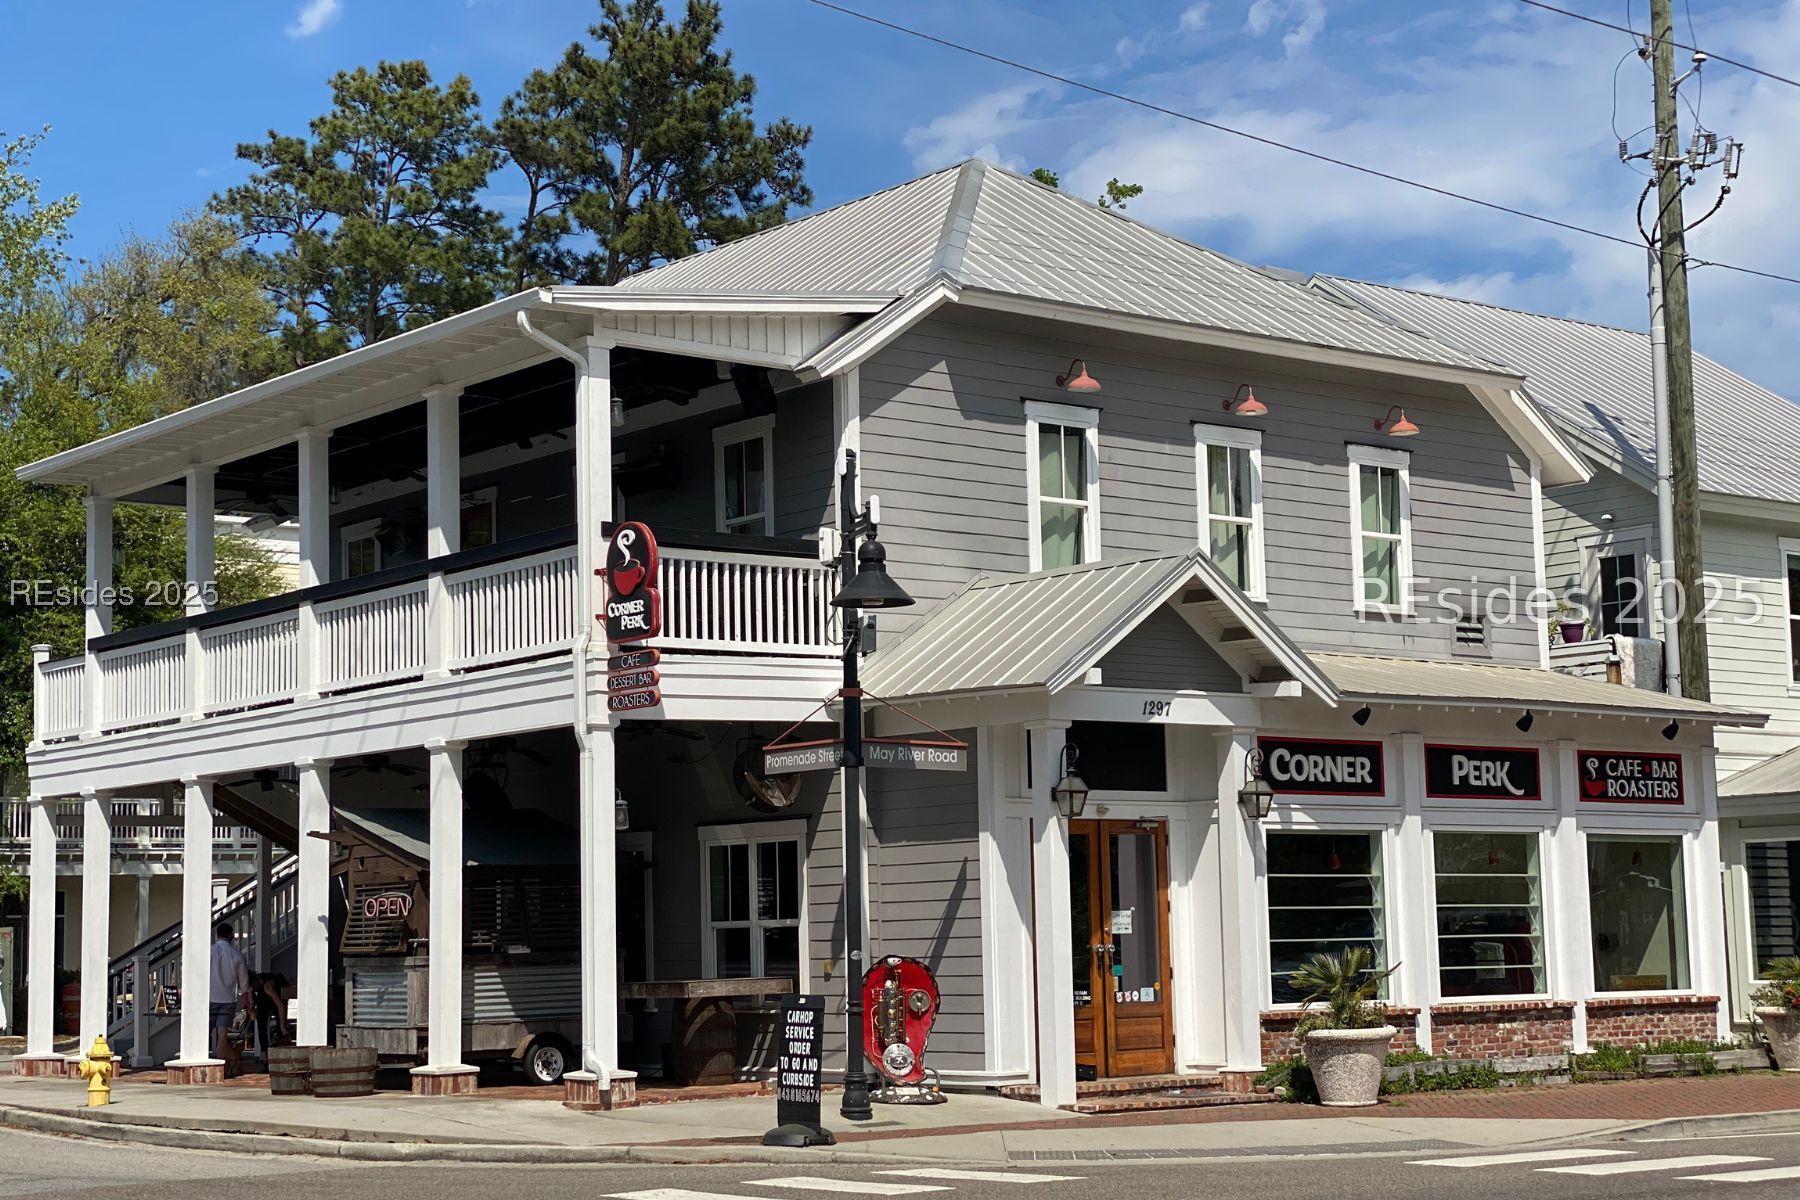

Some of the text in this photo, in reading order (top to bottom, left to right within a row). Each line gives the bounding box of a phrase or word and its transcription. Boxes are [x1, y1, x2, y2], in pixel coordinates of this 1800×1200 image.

[607, 599, 645, 618] CORNER
[620, 614, 650, 631] PERK
[621, 653, 641, 668] CAFE
[610, 671, 652, 690] DESSERT BAR
[612, 692, 650, 709] ROASTERS
[1142, 700, 1172, 717] 1297
[766, 749, 844, 769] Promenade Street
[869, 746, 958, 763] May River Road
[1269, 748, 1373, 784] CORNER
[1605, 758, 1678, 779] CAFE BAR
[1452, 754, 1525, 796] PERK
[1607, 780, 1679, 799] ROASTERS
[365, 898, 409, 917] OPEN
[787, 1010, 814, 1024] CARHOP
[785, 1026, 815, 1040] SERVICE
[789, 1041, 811, 1055] ORDER
[780, 1056, 818, 1072] TO GO AND
[782, 1072, 814, 1087] CURBSIDE
